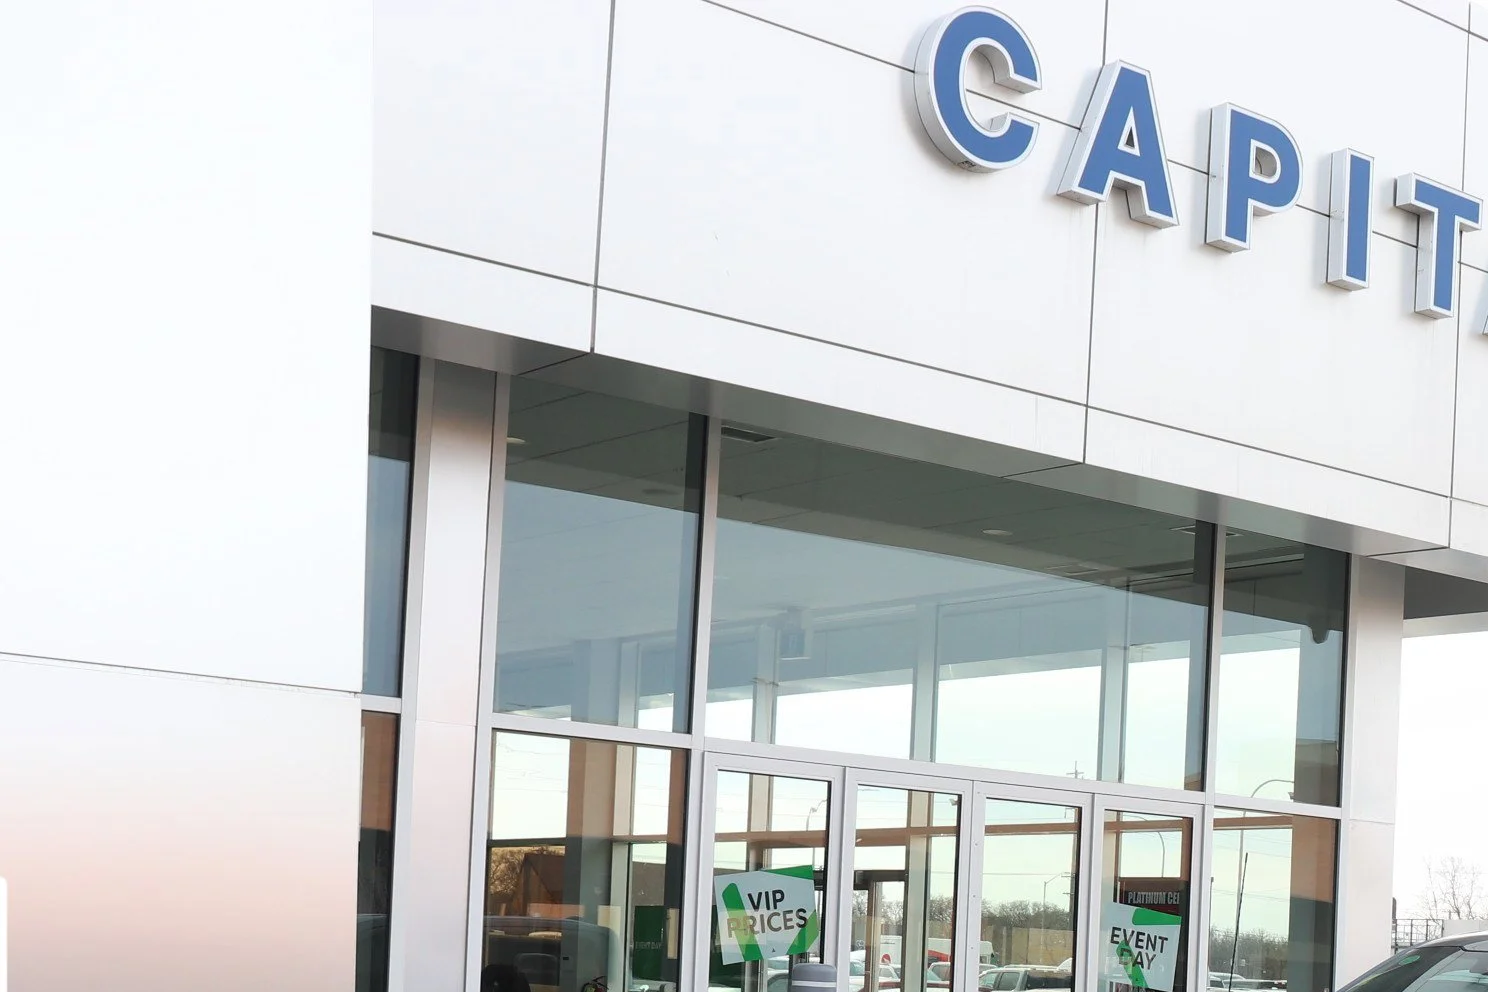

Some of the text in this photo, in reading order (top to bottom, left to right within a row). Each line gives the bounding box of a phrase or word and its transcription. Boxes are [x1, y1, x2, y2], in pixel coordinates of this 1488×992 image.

[747, 889, 785, 912] VIP
[1127, 891, 1166, 905] PLATINUM
[727, 908, 809, 939] PRICES
[1110, 926, 1169, 954] EVENT
[1118, 947, 1157, 970] DAY
